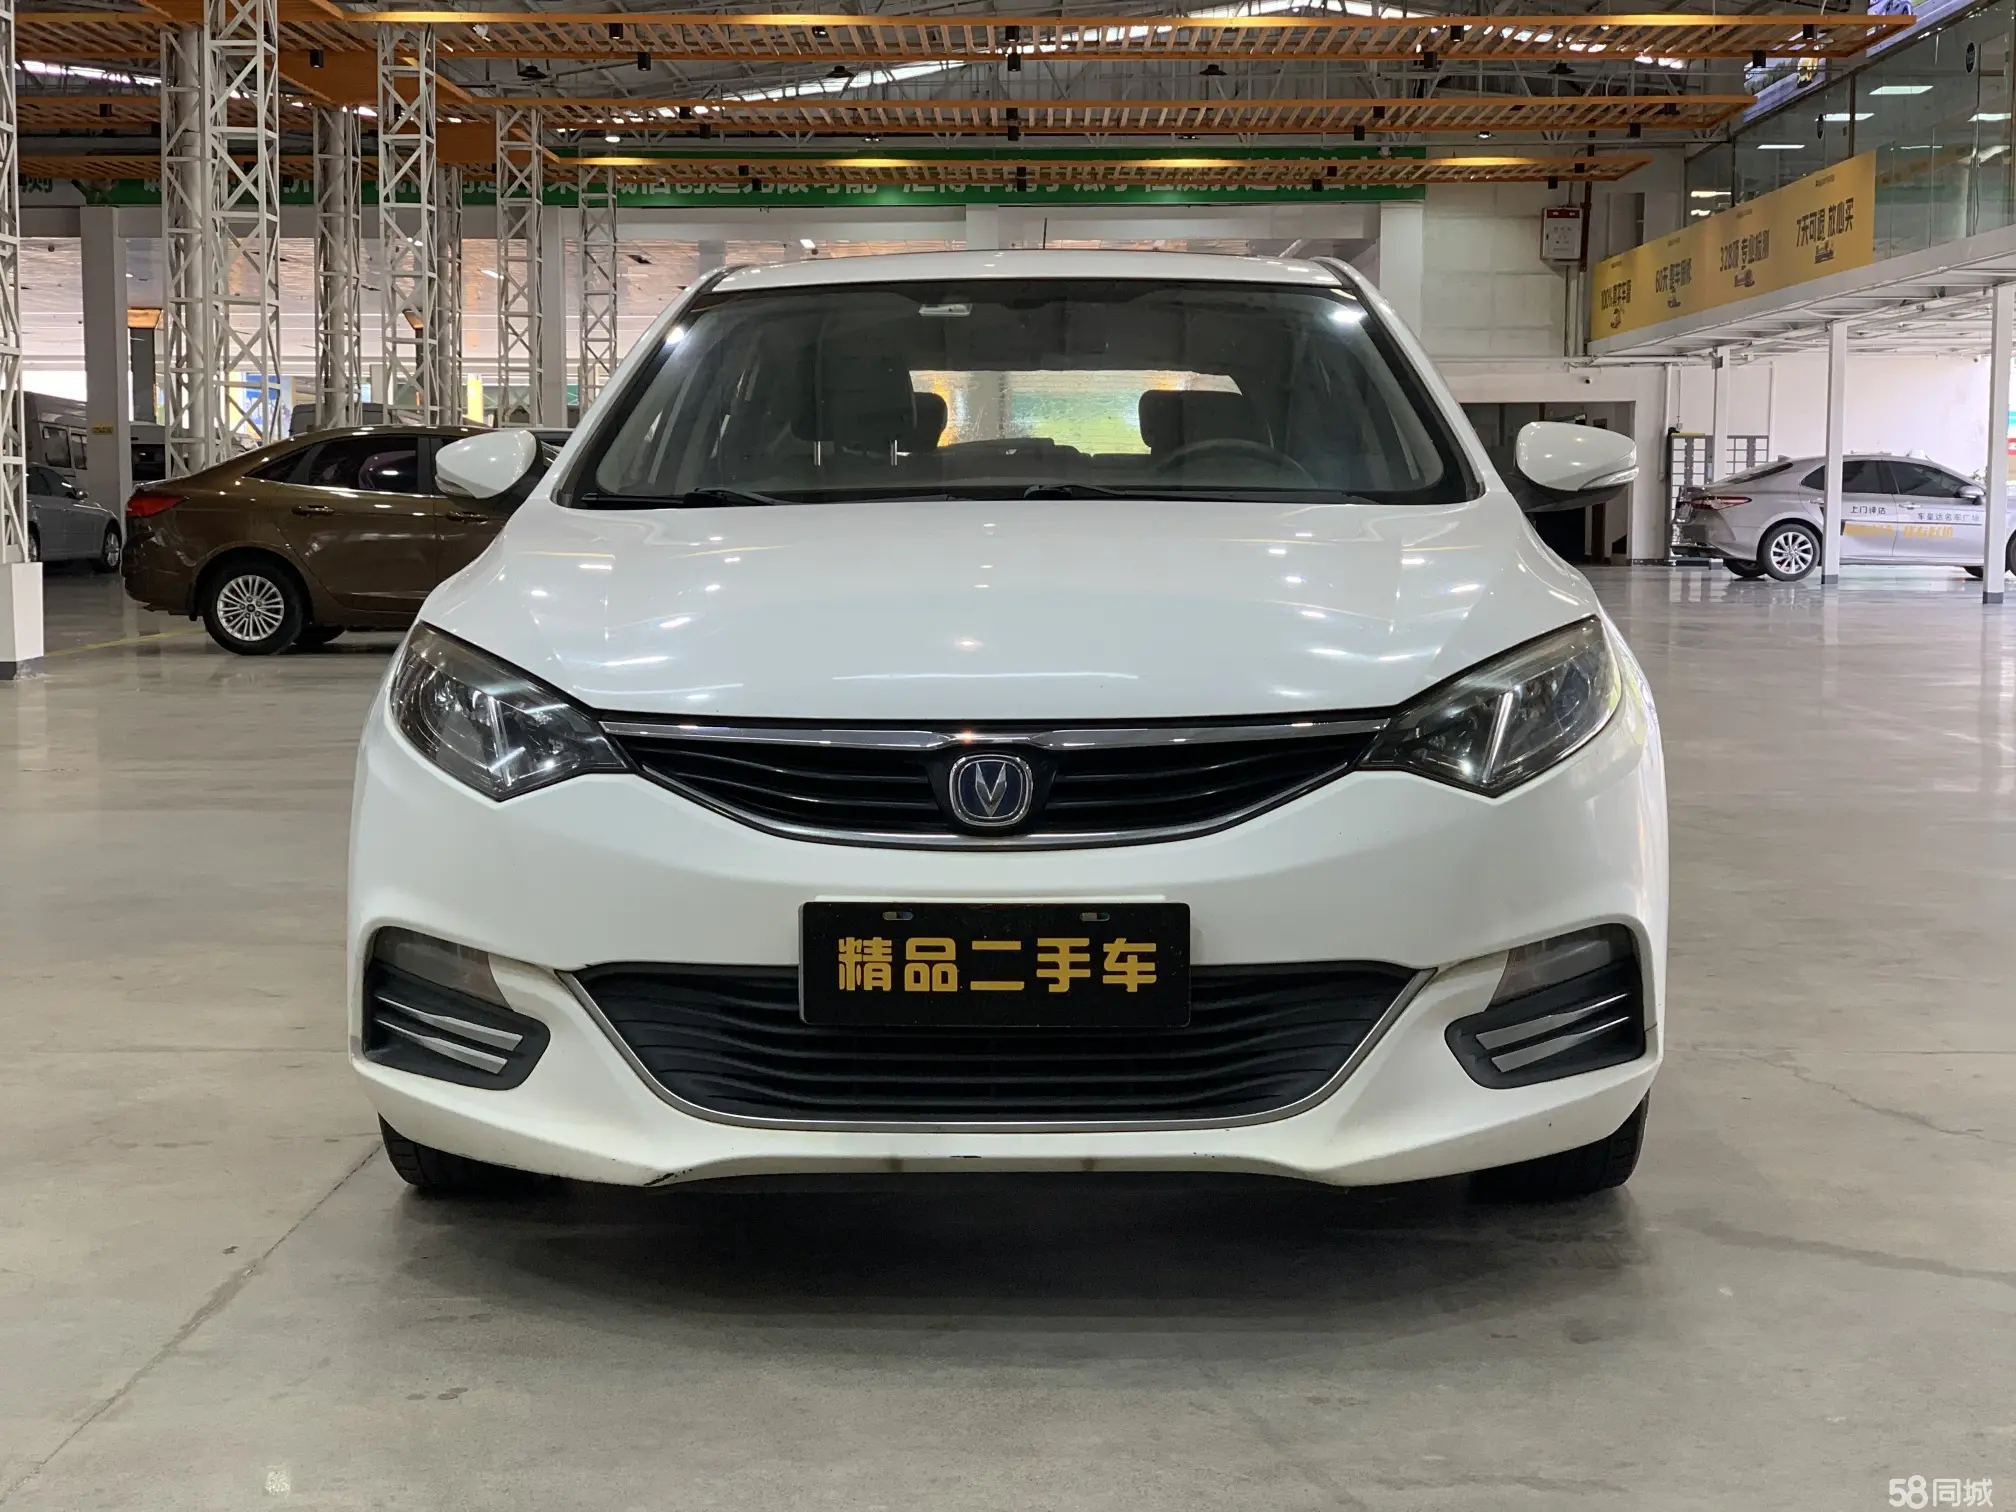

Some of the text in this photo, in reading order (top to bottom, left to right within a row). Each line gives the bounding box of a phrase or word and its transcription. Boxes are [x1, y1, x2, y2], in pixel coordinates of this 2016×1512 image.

[1828, 197, 1855, 237] 放心买
[837, 936, 1158, 993] 精品二手车
